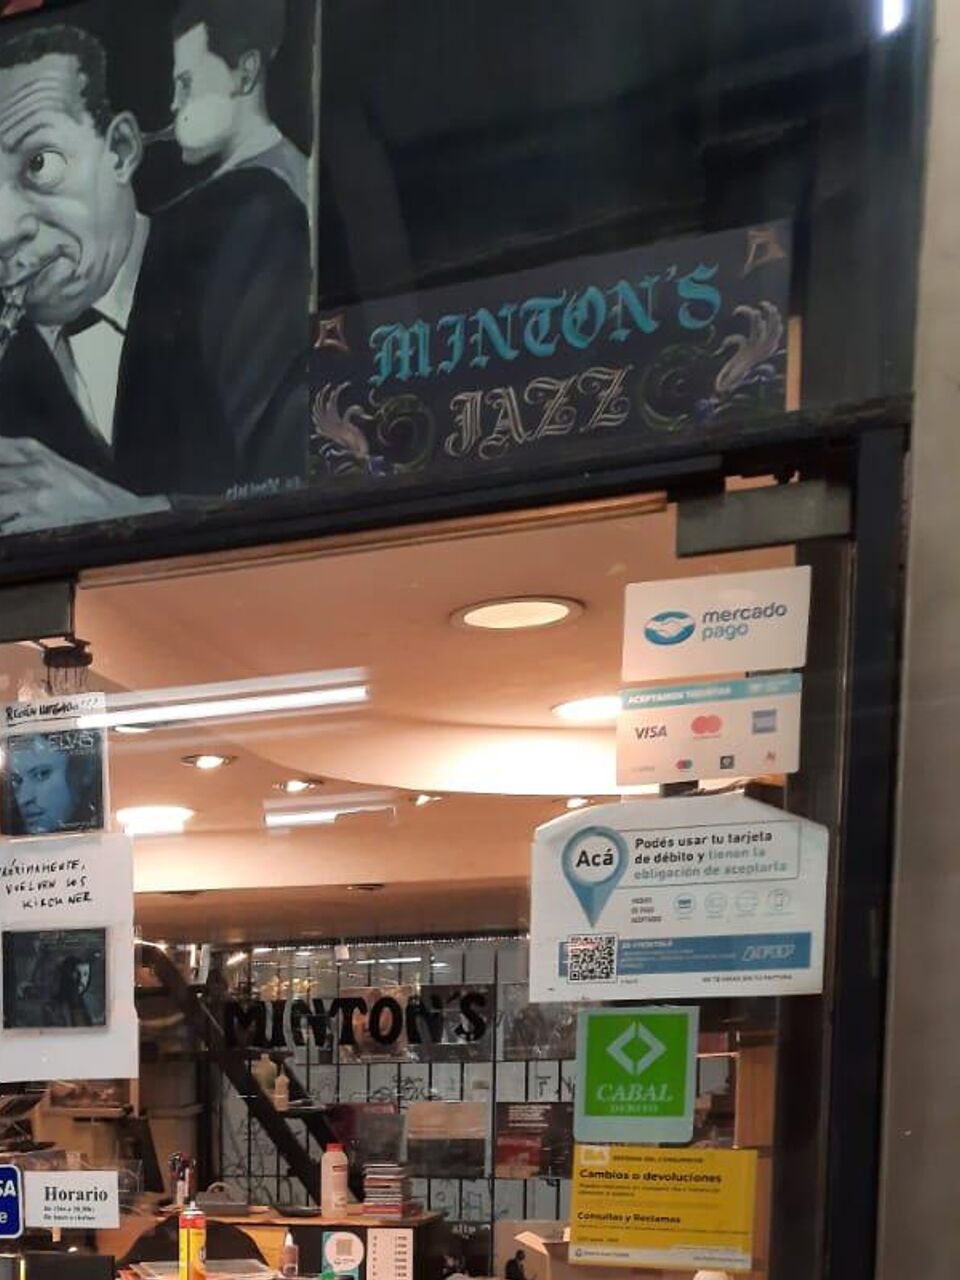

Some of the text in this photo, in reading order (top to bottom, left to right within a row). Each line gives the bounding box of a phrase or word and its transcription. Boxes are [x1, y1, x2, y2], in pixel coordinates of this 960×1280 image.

[368, 262, 722, 386] MINTON'S
[444, 366, 633, 461] JAZZ
[702, 602, 787, 624] mercado
[702, 623, 748, 641] pago
[634, 724, 667, 740] VISA
[634, 831, 772, 850] Podés usar tu tarjeta
[575, 849, 614, 868] Acá
[634, 847, 765, 865] de débito y tienen la
[634, 860, 788, 881] obligación de aceptarla
[5, 876, 88, 895] VUELVEN LOS
[227, 993, 488, 1048] MINTON'S
[596, 1083, 673, 1103] CABAL
[579, 1168, 722, 1184] Cambios o devoluciones
[44, 1186, 108, 1201] Horario
[577, 1211, 681, 1224] Consultas y Reclamos
